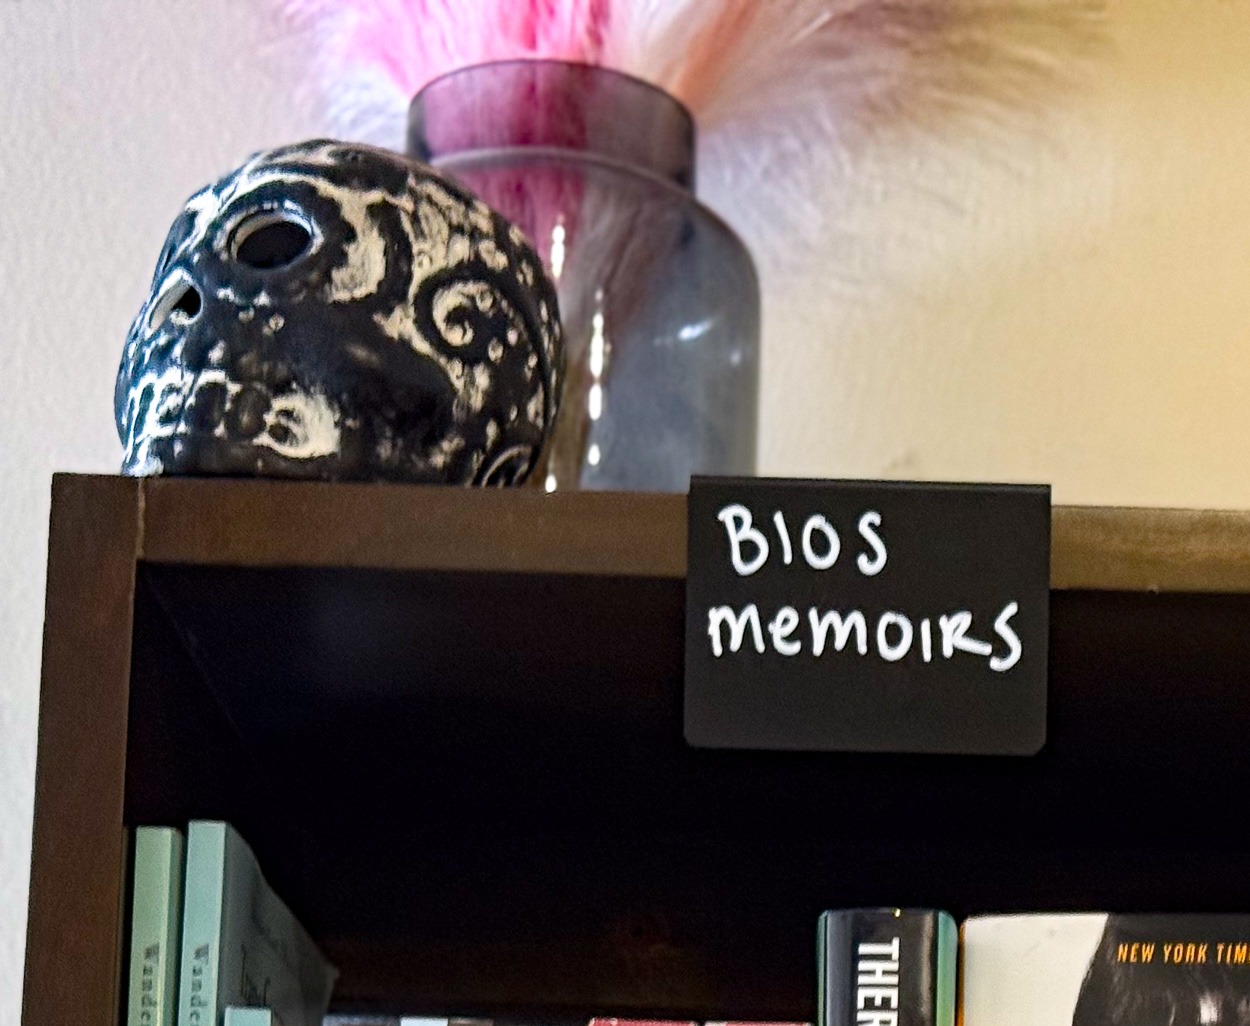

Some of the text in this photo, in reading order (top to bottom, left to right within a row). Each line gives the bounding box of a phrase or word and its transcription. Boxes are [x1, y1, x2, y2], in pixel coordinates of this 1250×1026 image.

[718, 503, 888, 577] BIOS
[1117, 942, 1154, 965] NEW
[1163, 943, 1208, 965] YORK
